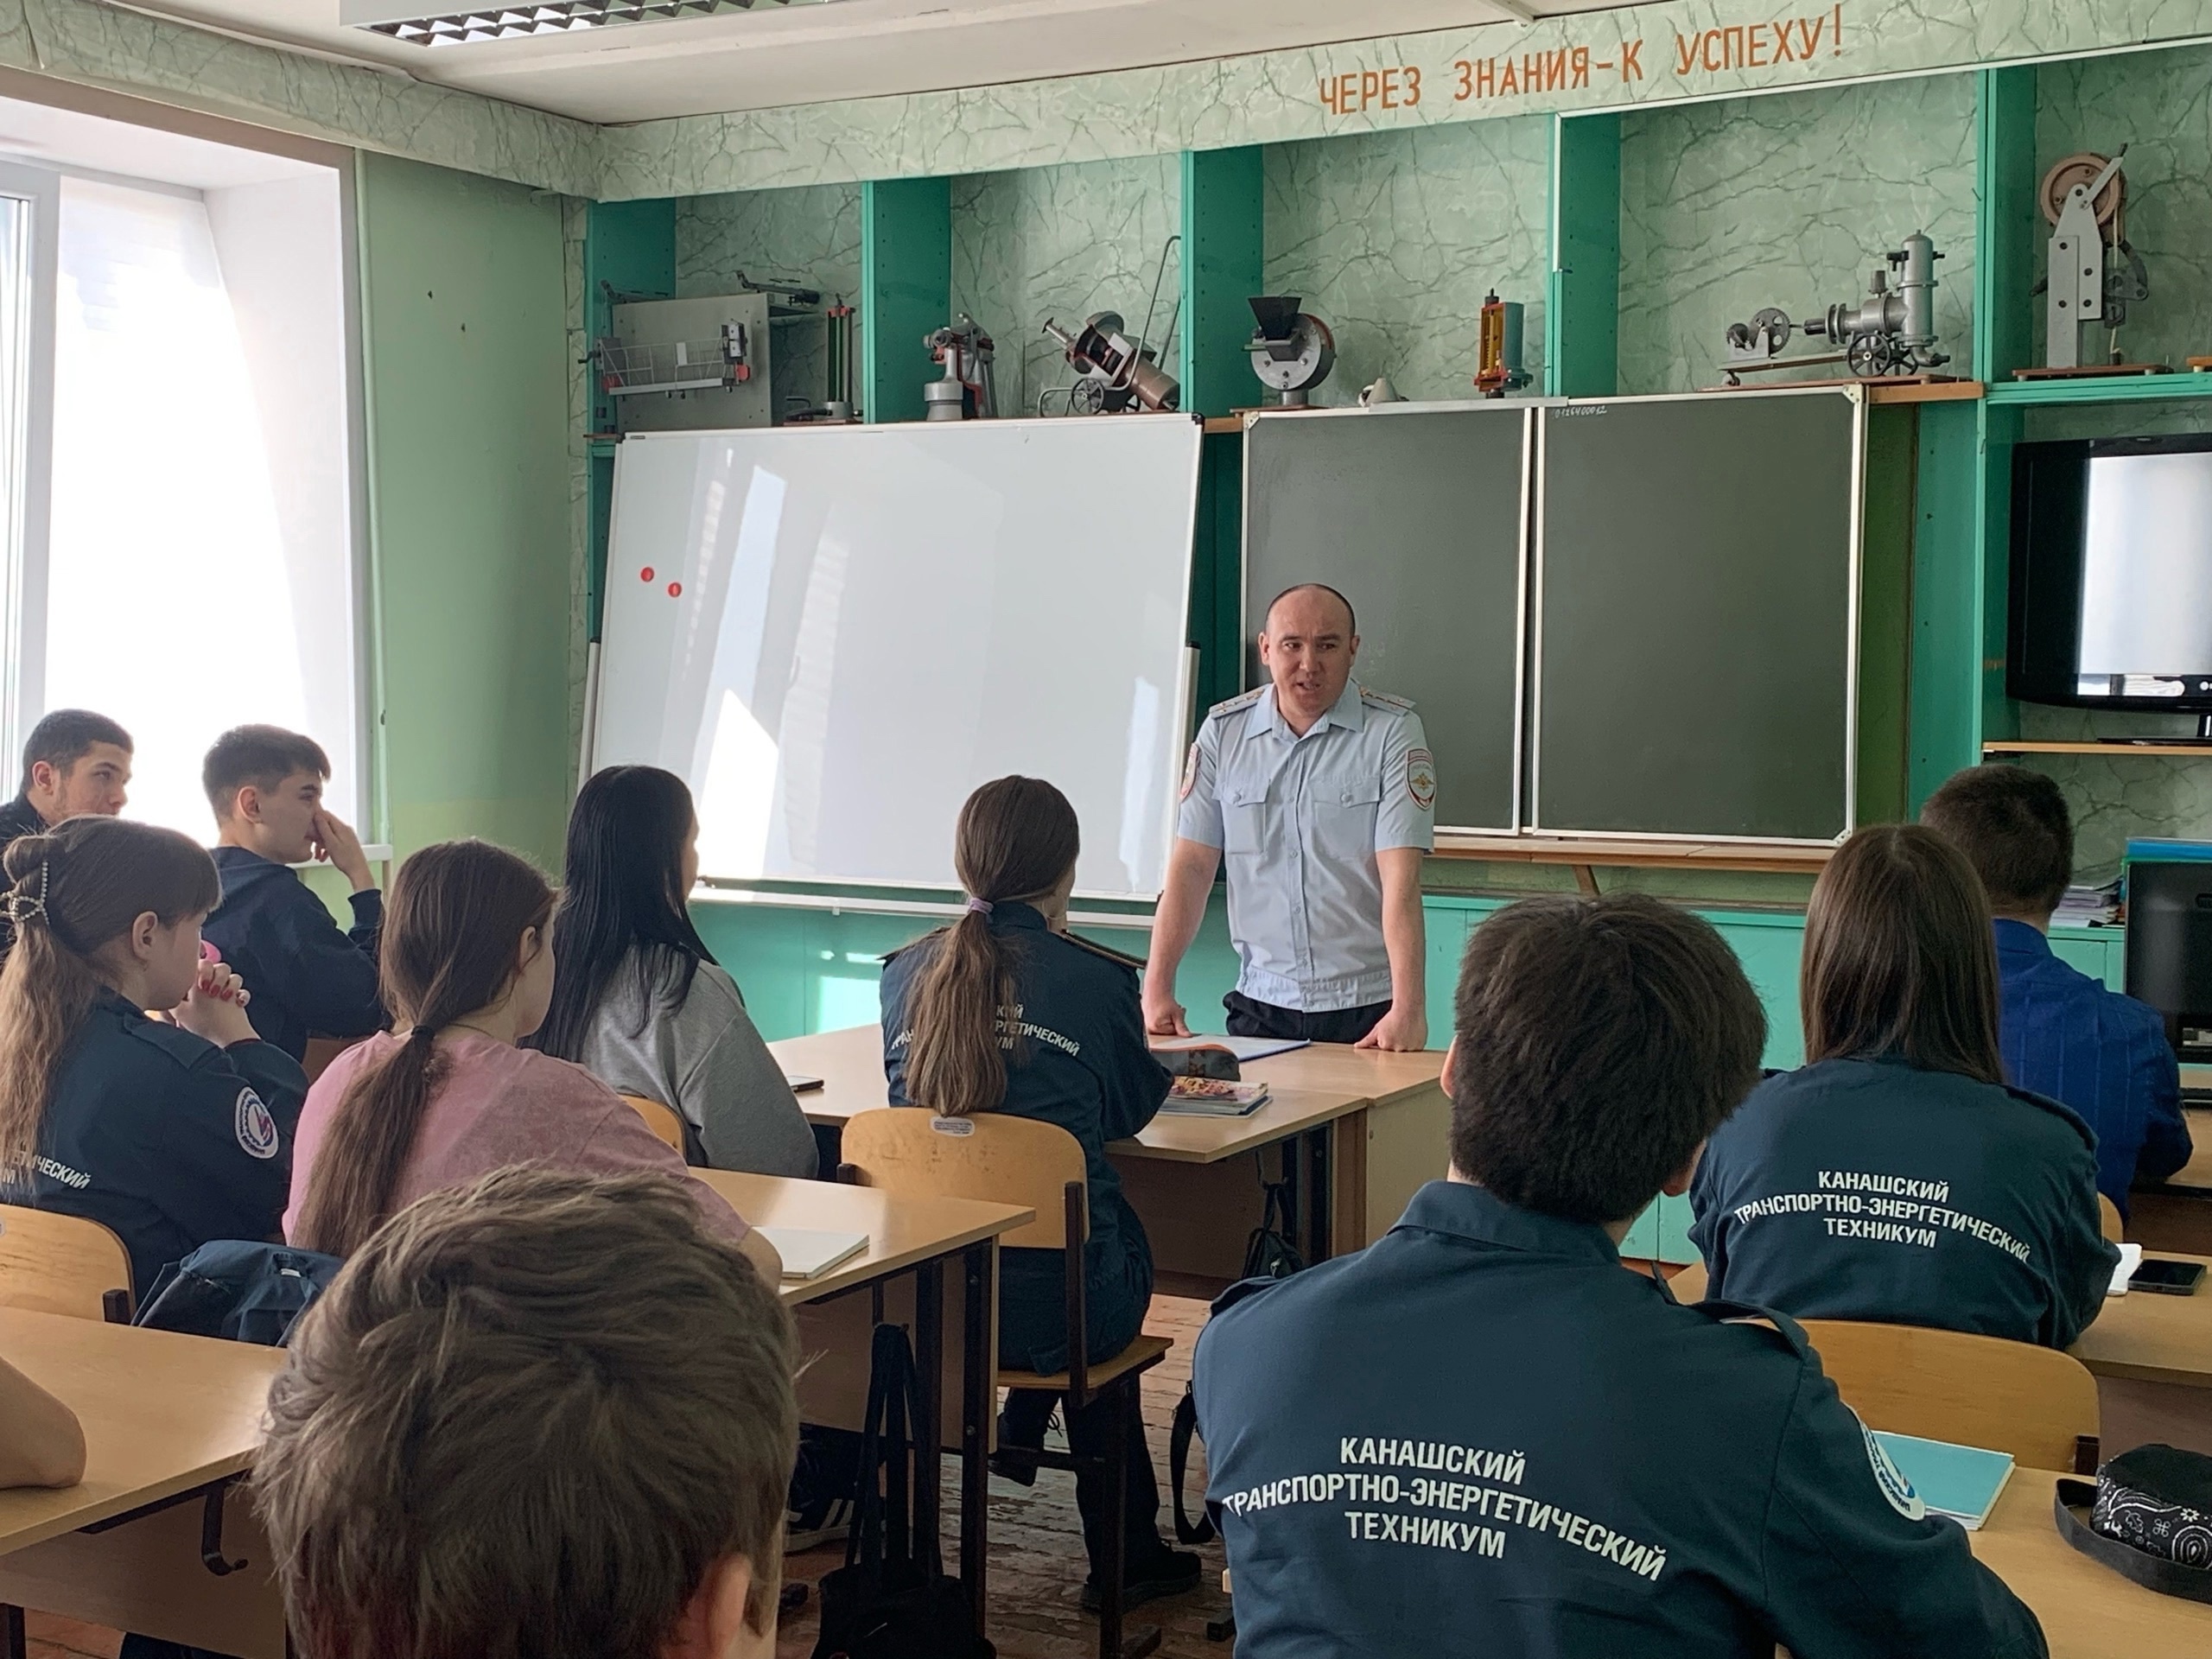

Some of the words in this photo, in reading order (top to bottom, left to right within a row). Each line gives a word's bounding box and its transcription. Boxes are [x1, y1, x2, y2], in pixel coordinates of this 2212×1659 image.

[1318, 65, 1422, 116] ЧЕРЕЗ
[1675, 3, 1842, 77] УСПЕХУ!
[1818, 1170, 1949, 1204] КАНАШСКИЙ
[1733, 1193, 2031, 1264] ТРАНСПОРТНО-ЭНЕРГЕТИЧЕСКИЙ
[1823, 1217, 1937, 1249] ТЕХНИКУМ
[1340, 1437, 1526, 1485] КАНАШСКИЙ
[1221, 1473, 1667, 1581] ТРАНСПОРТНО-ЭНЕРГЕТИЧЕСКИЙ
[1343, 1511, 1506, 1559] ТЕХНИКУМ
